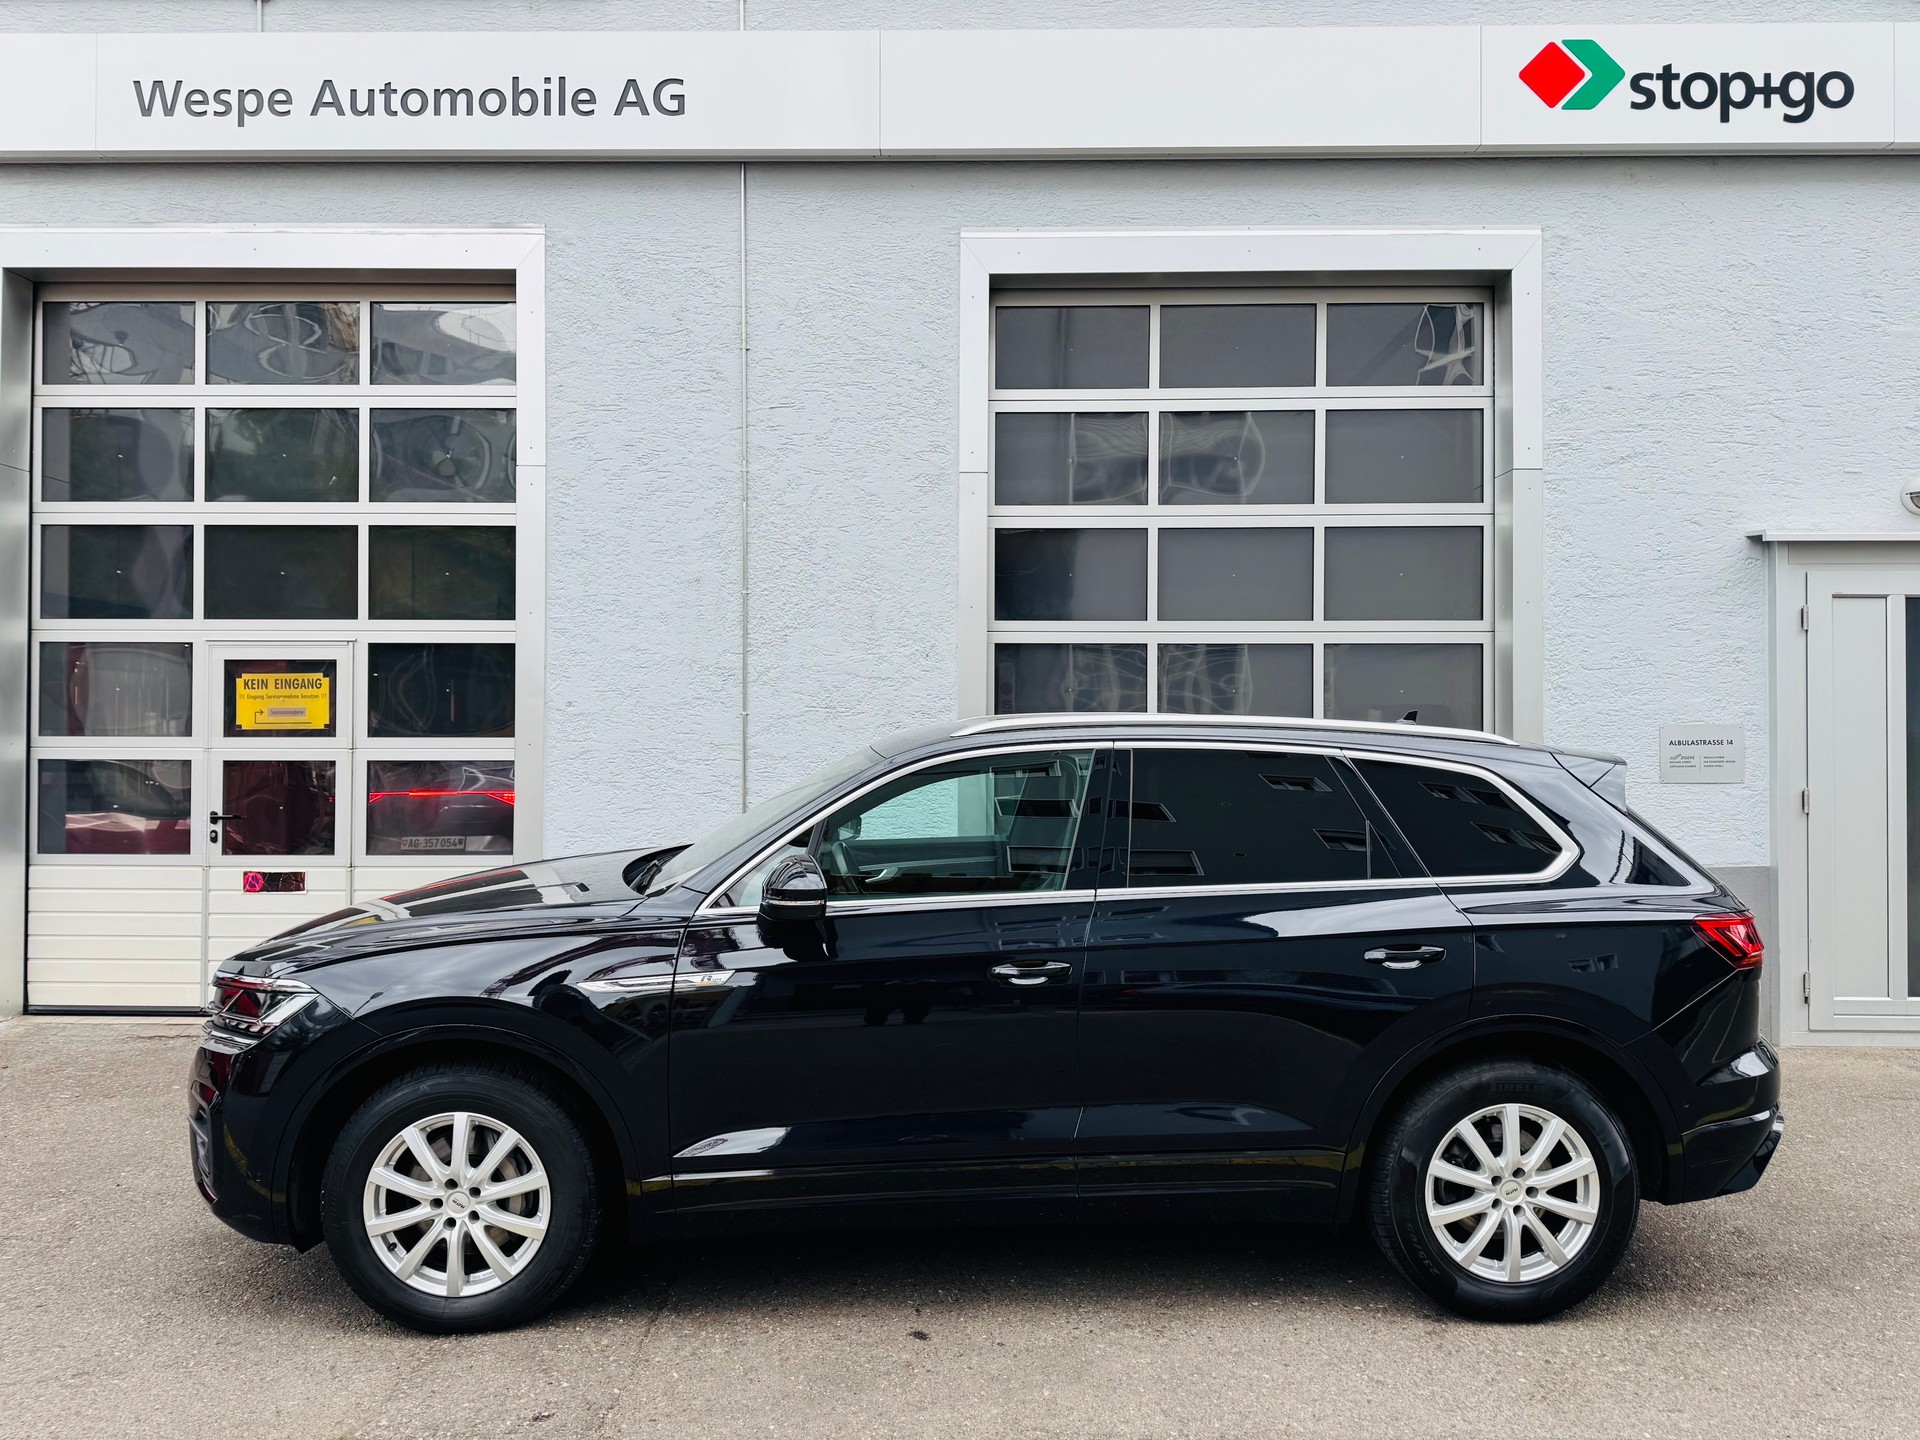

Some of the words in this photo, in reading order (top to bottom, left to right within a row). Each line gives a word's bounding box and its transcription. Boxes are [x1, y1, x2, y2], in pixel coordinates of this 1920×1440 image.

[133, 79, 294, 128] Wespe
[310, 75, 599, 119] Automobile
[613, 77, 688, 118] AG
[1629, 62, 1855, 124] stop+go
[243, 678, 269, 690] KEIN
[274, 678, 323, 690] EINGANG
